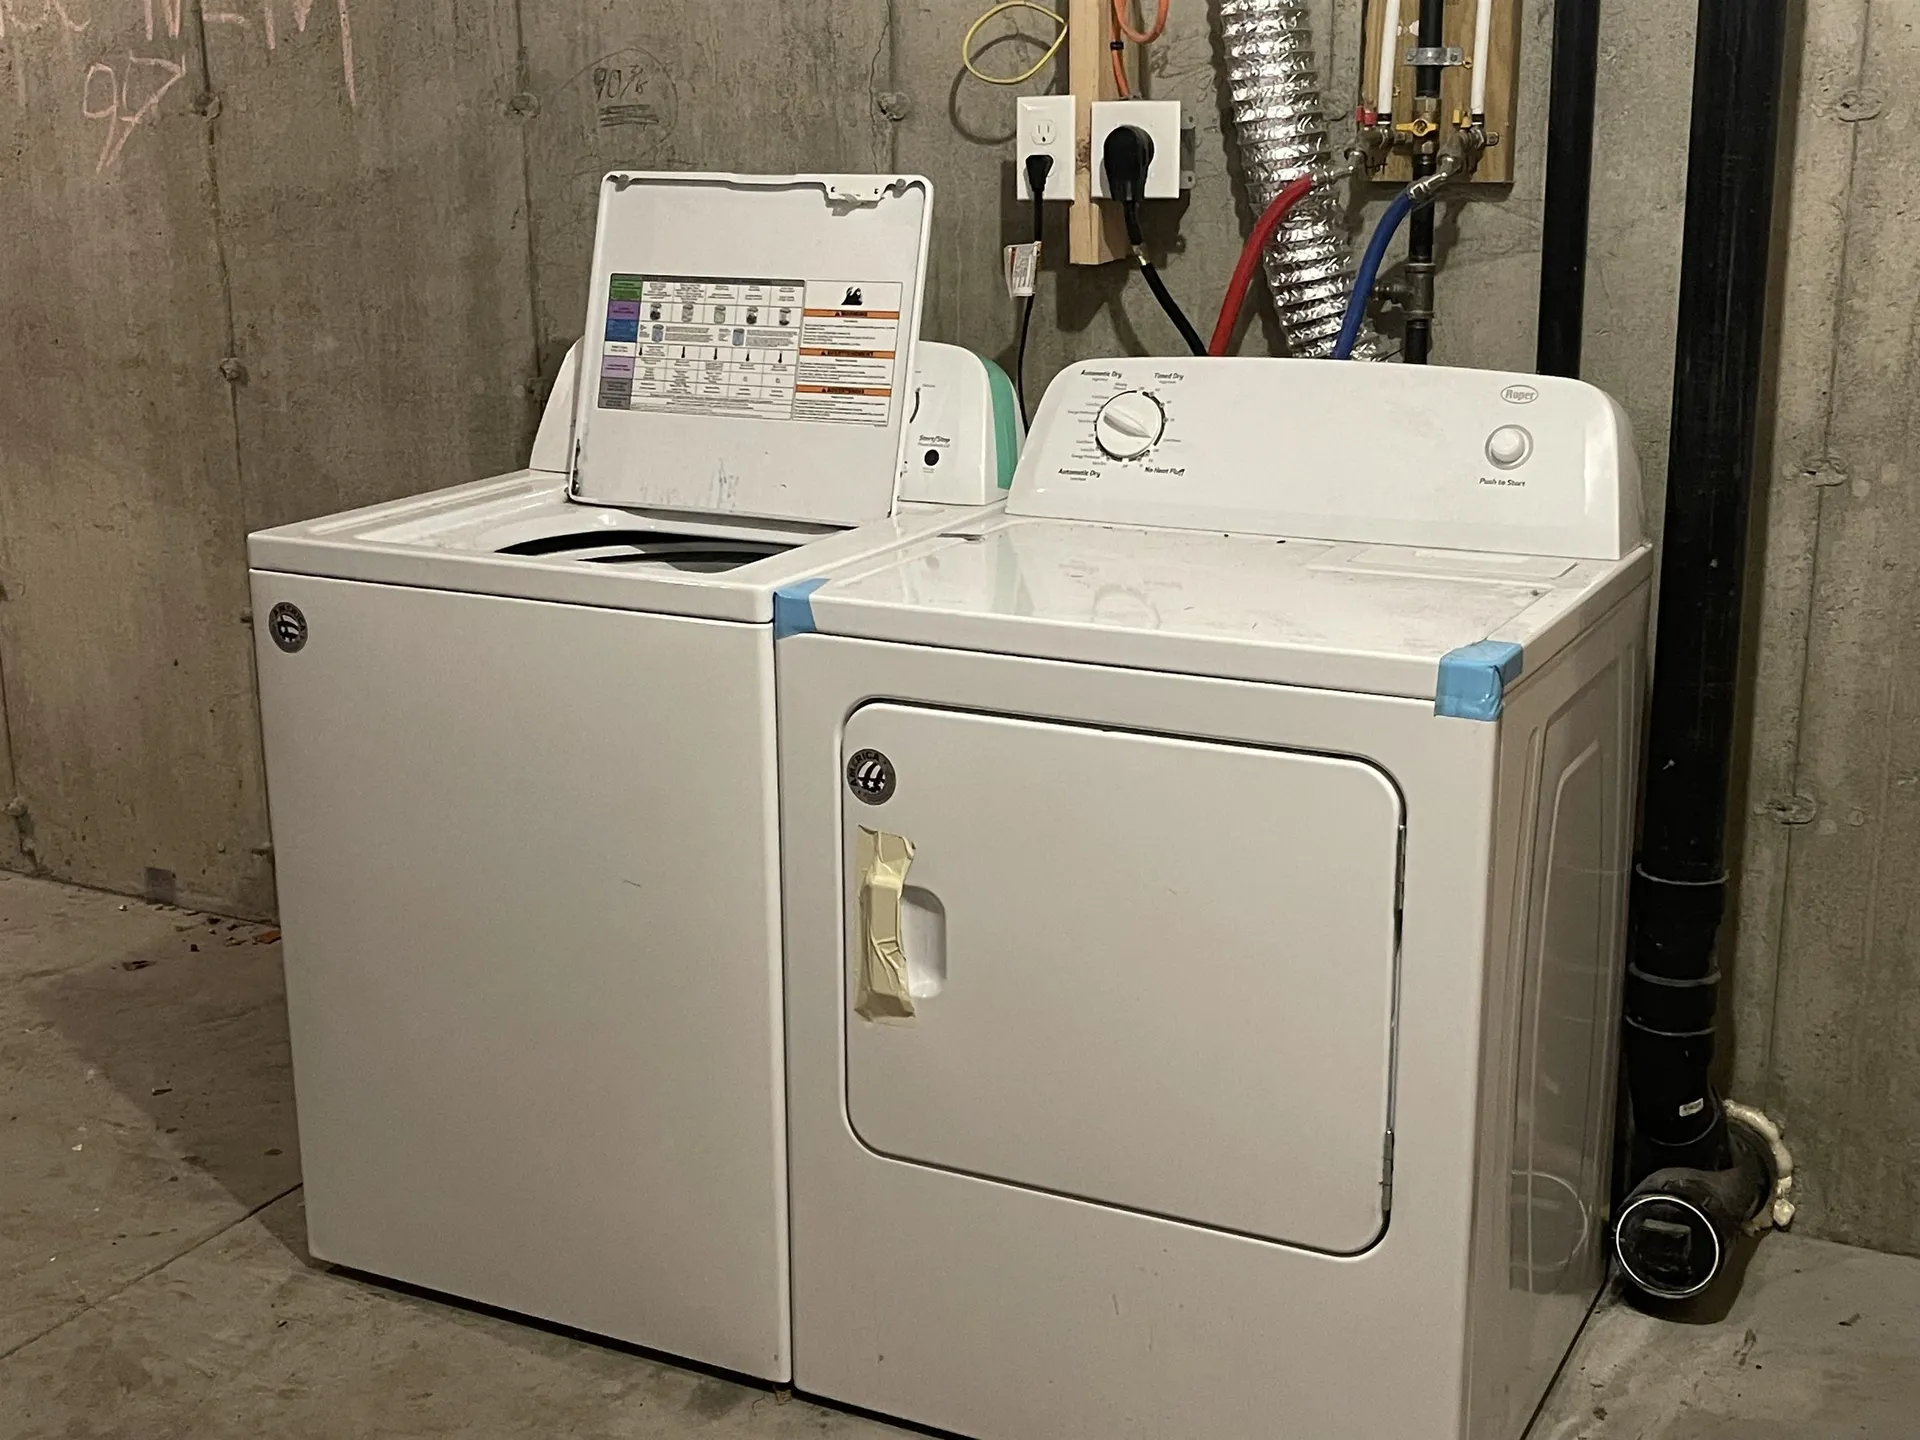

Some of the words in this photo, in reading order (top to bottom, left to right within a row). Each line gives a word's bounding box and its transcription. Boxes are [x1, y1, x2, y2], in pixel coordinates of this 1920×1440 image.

[1111, 371, 1123, 379] Dry
[1154, 372, 1171, 380] Timed
[1172, 373, 1184, 381] Dry
[1505, 389, 1535, 401] Roper
[1058, 468, 1089, 476] Automatic
[1089, 469, 1101, 479] Dry
[1145, 466, 1154, 474] No
[1479, 477, 1497, 485] Push
[1507, 479, 1526, 487] Start
